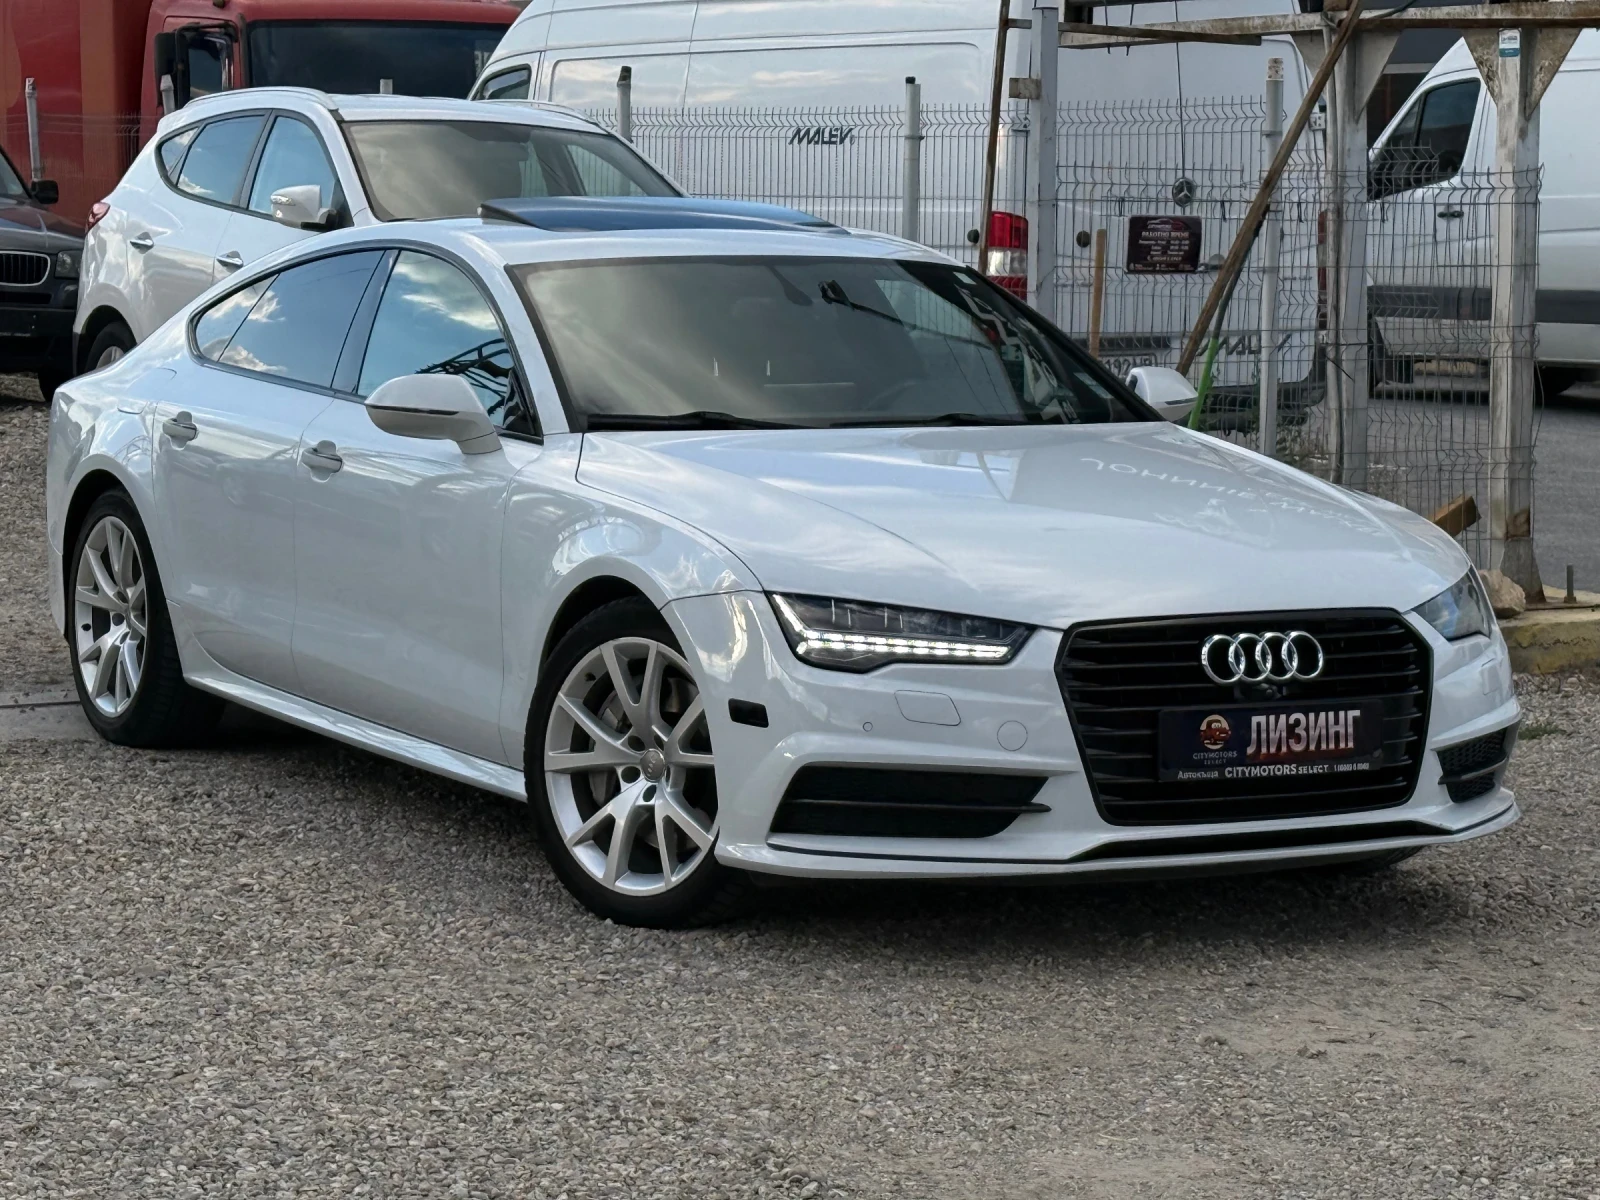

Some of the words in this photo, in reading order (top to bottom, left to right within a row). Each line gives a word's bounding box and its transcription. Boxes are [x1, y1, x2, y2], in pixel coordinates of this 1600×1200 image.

[788, 127, 853, 145] MALEV
[1247, 709, 1361, 755] ЛИЗИНГ
[1193, 751, 1238, 760] CITYMOTORS
[1225, 764, 1297, 779] CITYMOTORS
[1298, 765, 1329, 775] SELECT
